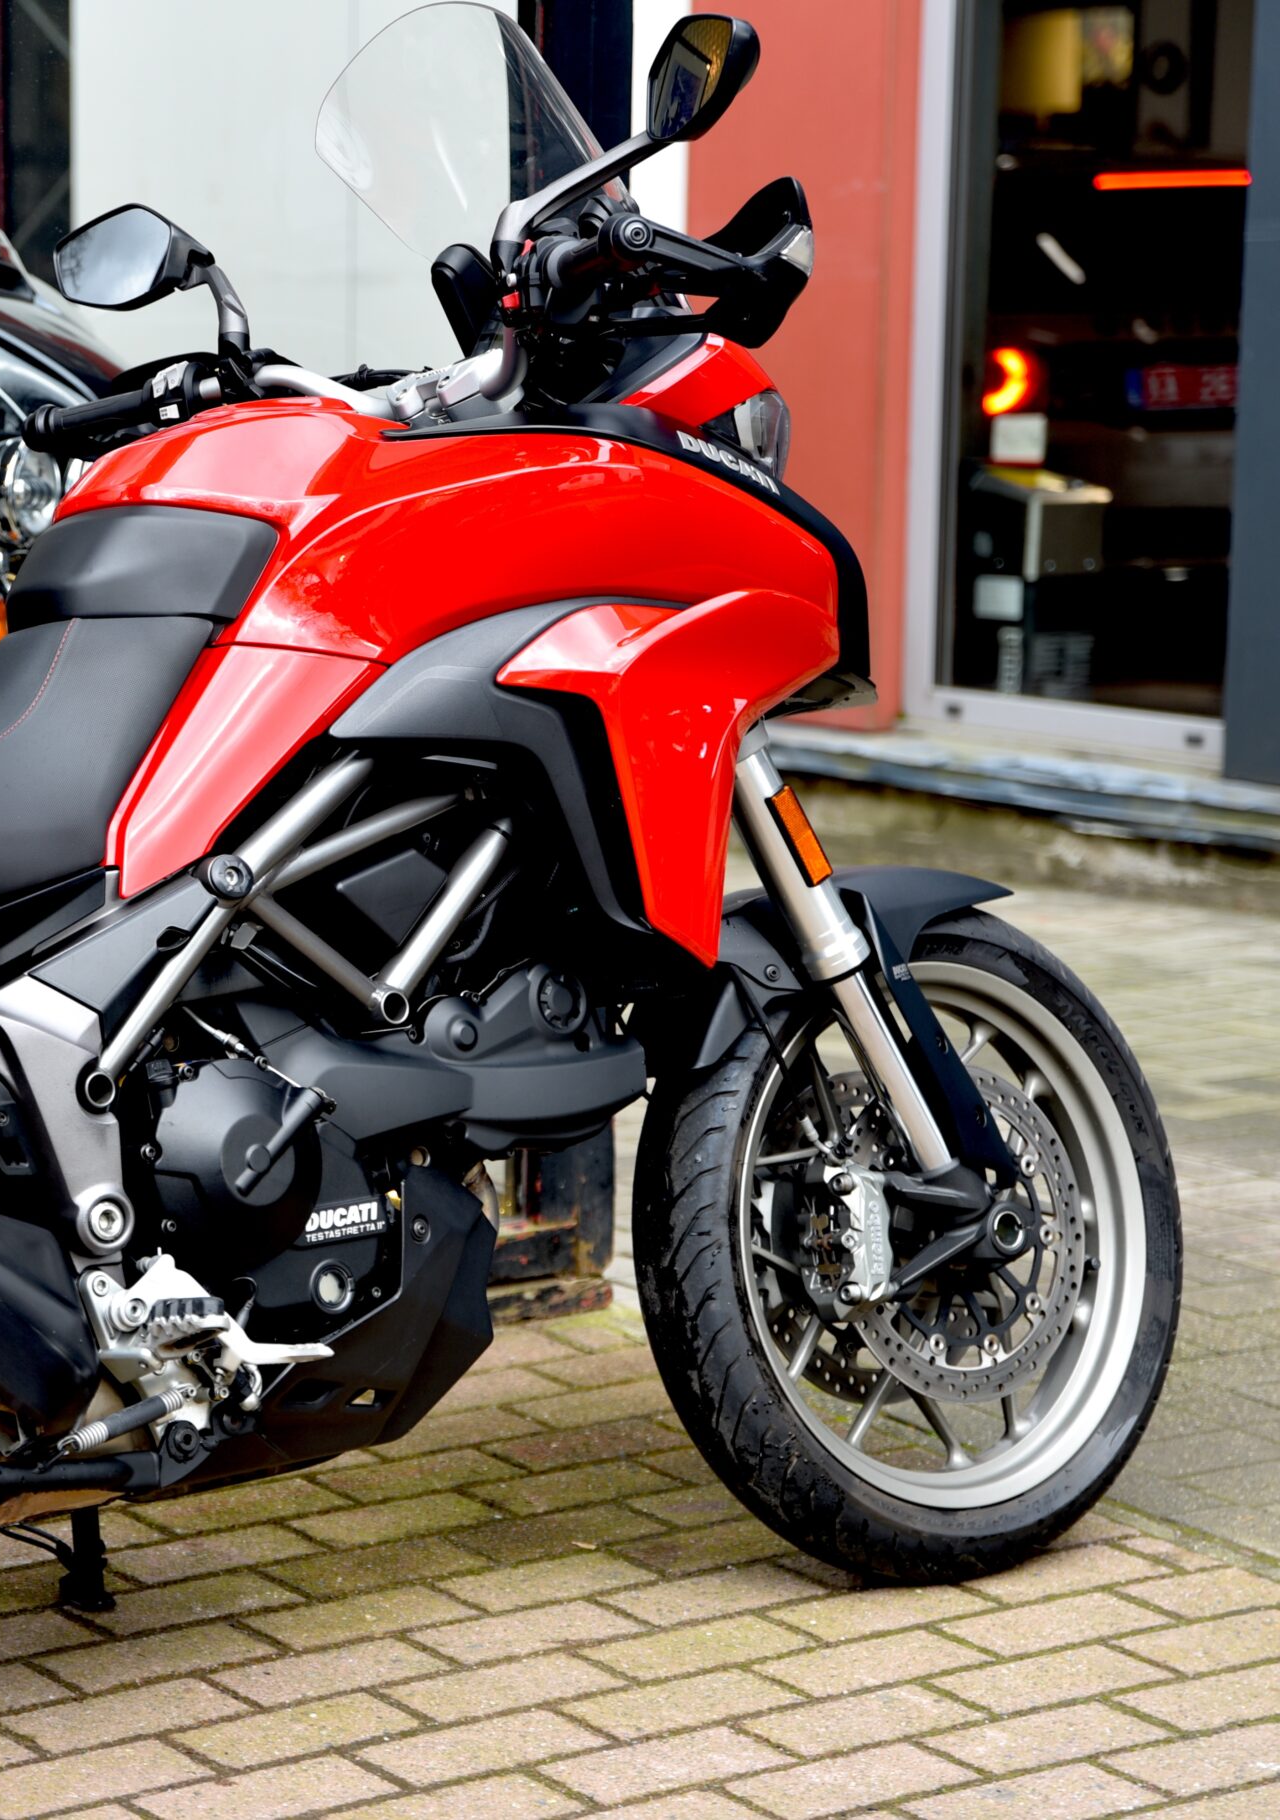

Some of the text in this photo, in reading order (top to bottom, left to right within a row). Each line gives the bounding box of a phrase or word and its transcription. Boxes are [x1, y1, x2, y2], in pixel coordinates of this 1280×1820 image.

[676, 430, 781, 496] DUCATI
[305, 1201, 378, 1232] DUCATI
[305, 1223, 376, 1243] TESTASTRETTA
[867, 1200, 886, 1276] brembo
